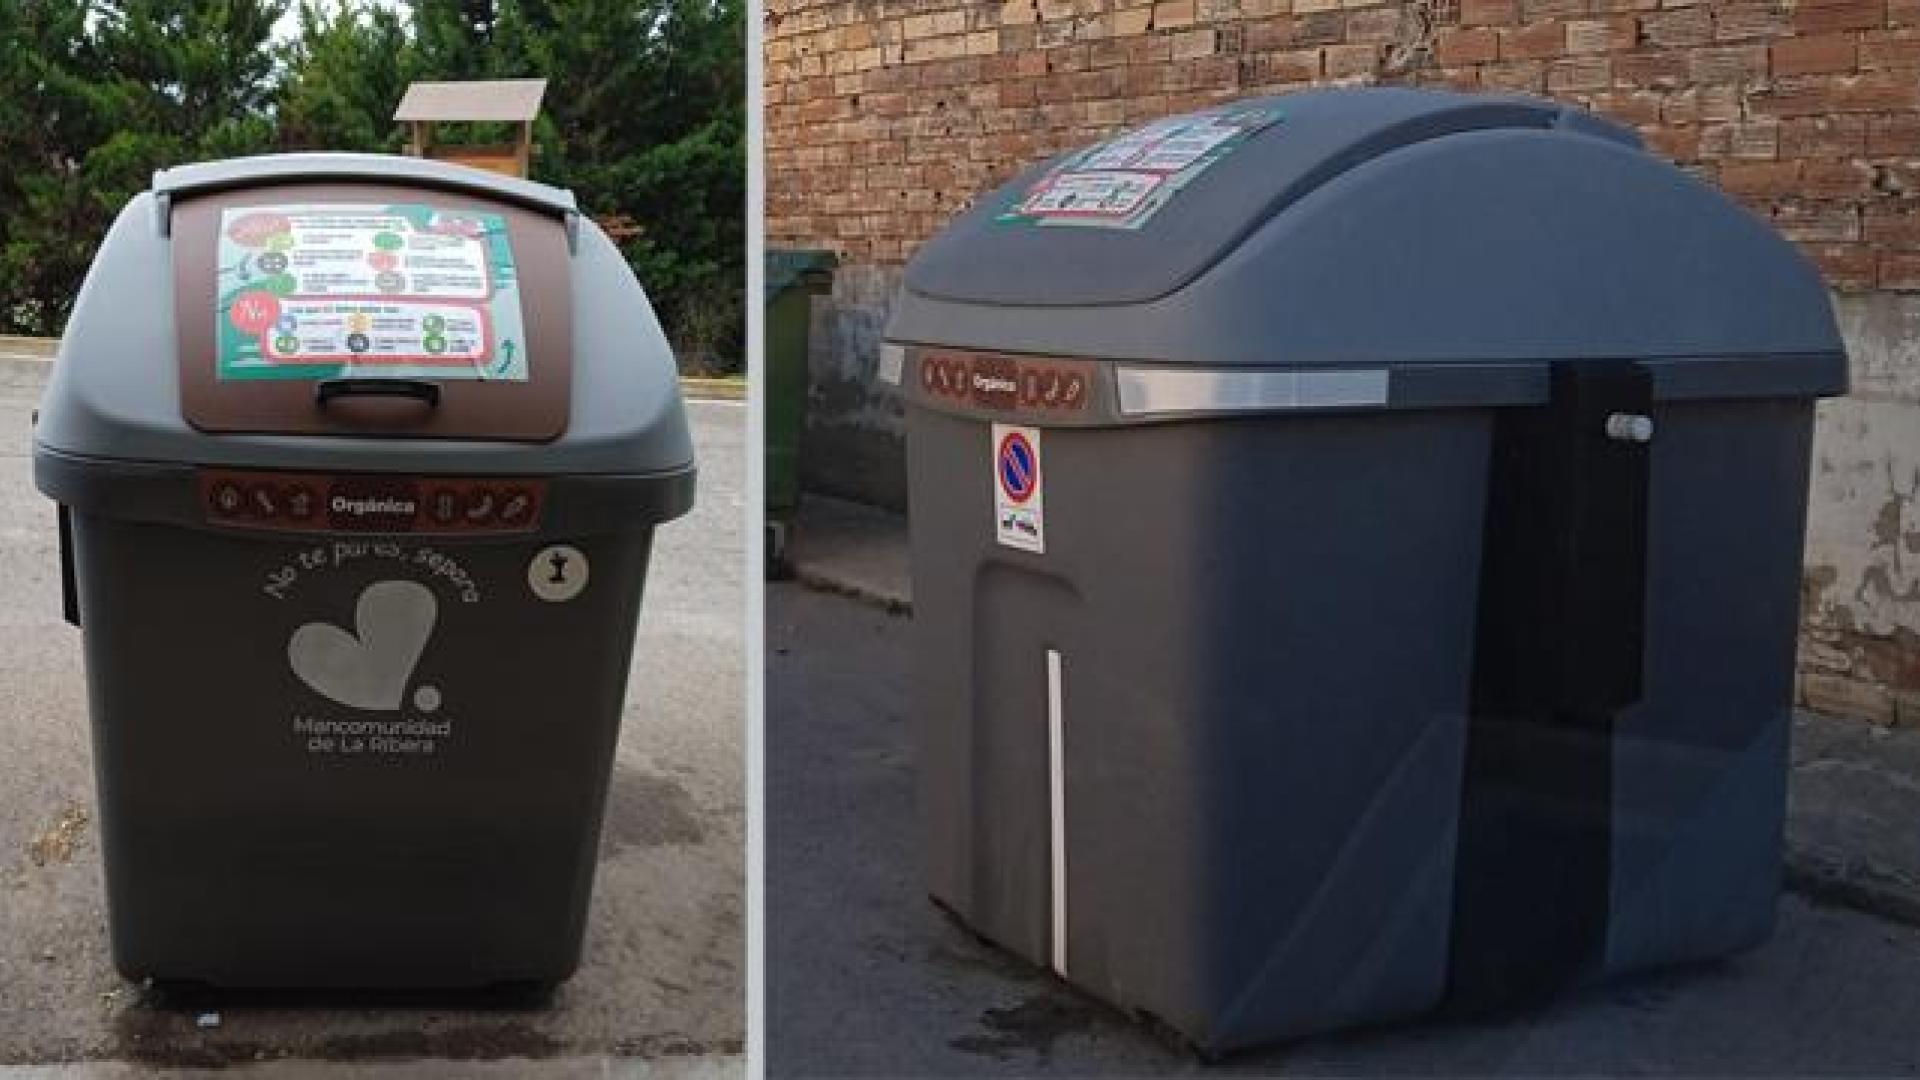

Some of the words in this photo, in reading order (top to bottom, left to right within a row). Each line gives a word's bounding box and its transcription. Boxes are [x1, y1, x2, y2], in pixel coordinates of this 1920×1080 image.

[332, 495, 415, 516] Orgánica
[263, 566, 296, 600] No
[300, 549, 328, 570] te
[293, 715, 453, 735] Mancomunidad
[308, 734, 334, 753] de
[342, 734, 364, 753] La
[371, 734, 435, 753] Ribera
